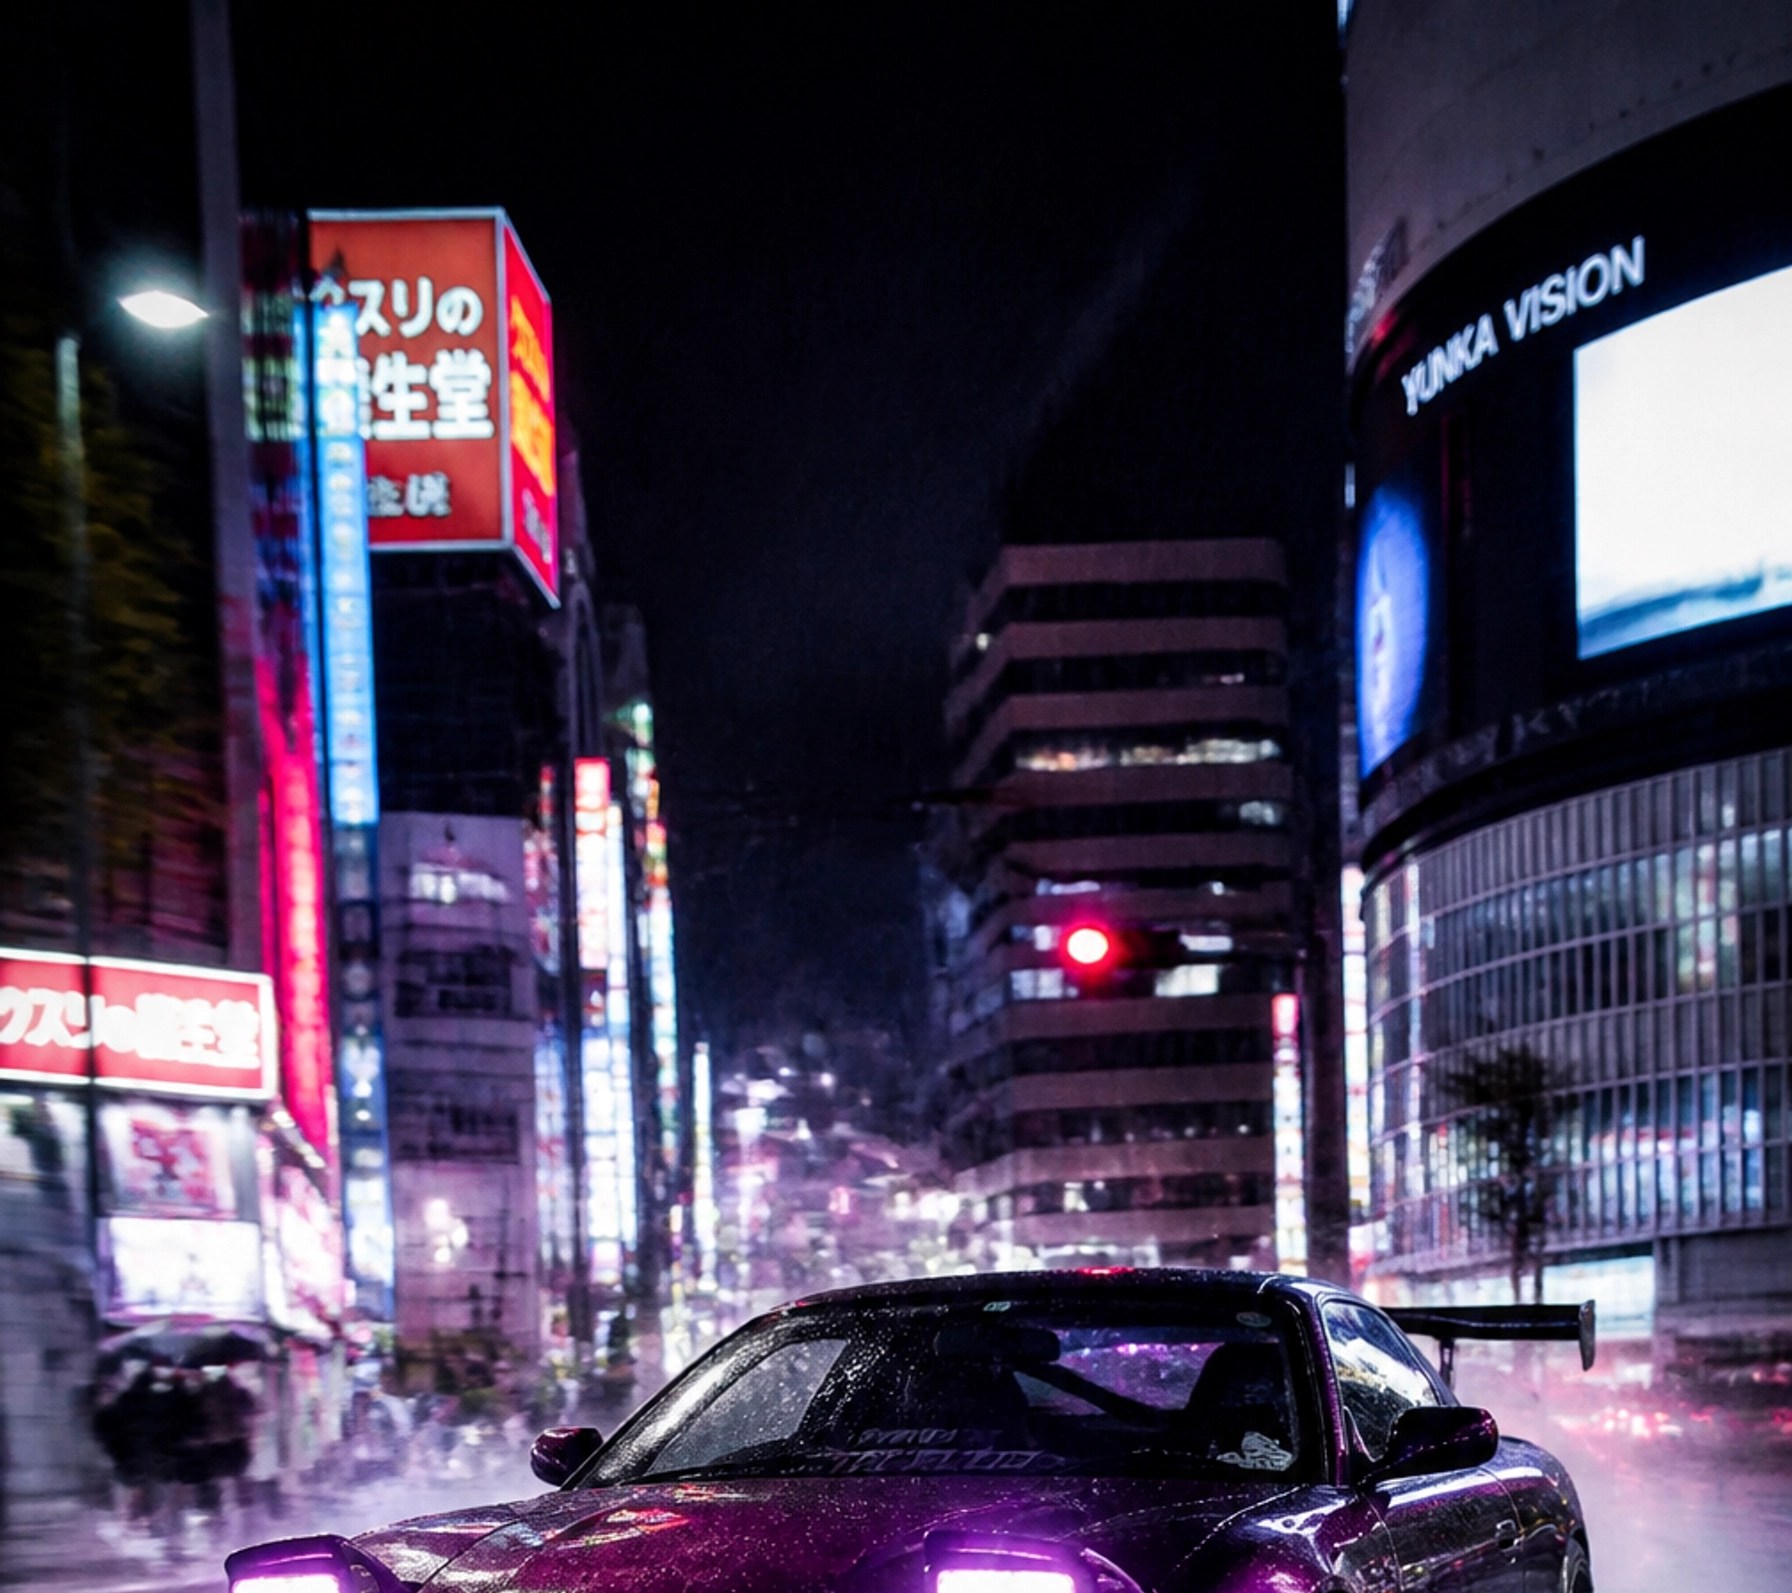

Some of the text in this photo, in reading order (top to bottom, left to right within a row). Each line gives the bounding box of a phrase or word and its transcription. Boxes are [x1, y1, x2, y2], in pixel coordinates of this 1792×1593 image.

[358, 348, 495, 440] 生堂
[1401, 234, 1646, 417] YUNKA VISION
